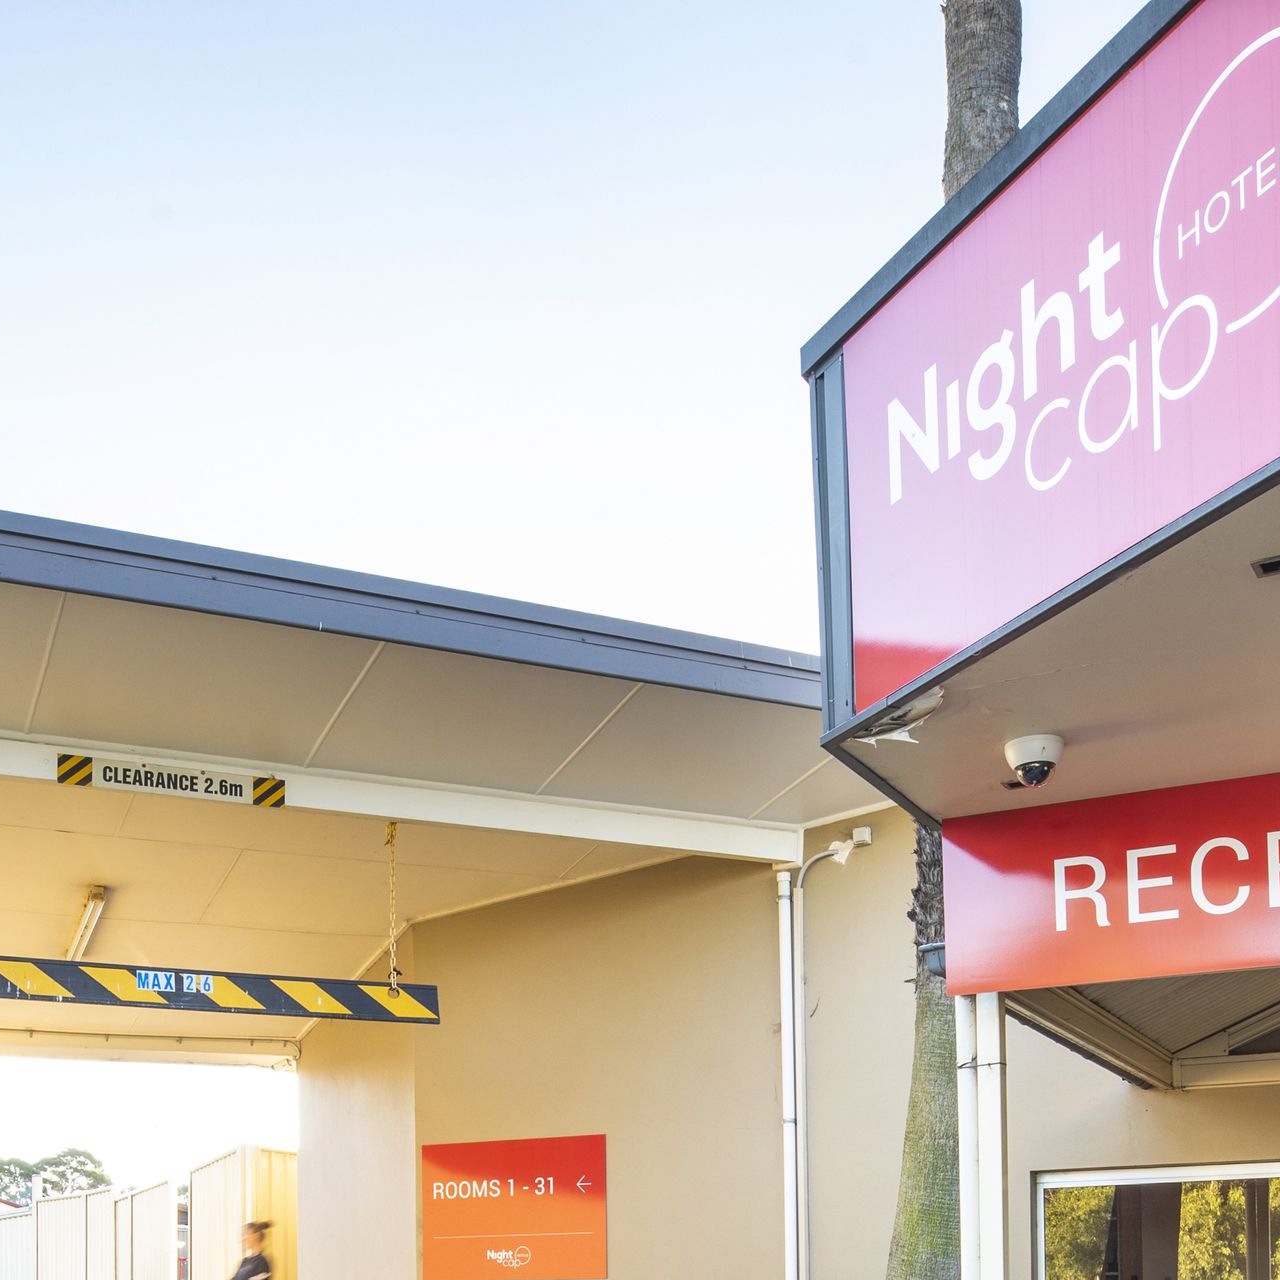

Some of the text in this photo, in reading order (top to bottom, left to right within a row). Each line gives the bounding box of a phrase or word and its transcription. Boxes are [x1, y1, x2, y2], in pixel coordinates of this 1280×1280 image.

[886, 231, 1123, 504] Night
[1024, 293, 1218, 492] cap
[103, 765, 243, 796] CLEARANCE 2.6m
[137, 971, 174, 991] MAX
[433, 1179, 501, 1200] ROOMS
[507, 1178, 515, 1197] 1
[534, 1176, 555, 1196] 31
[486, 1249, 514, 1264] Night
[502, 1258, 521, 1269] cap
